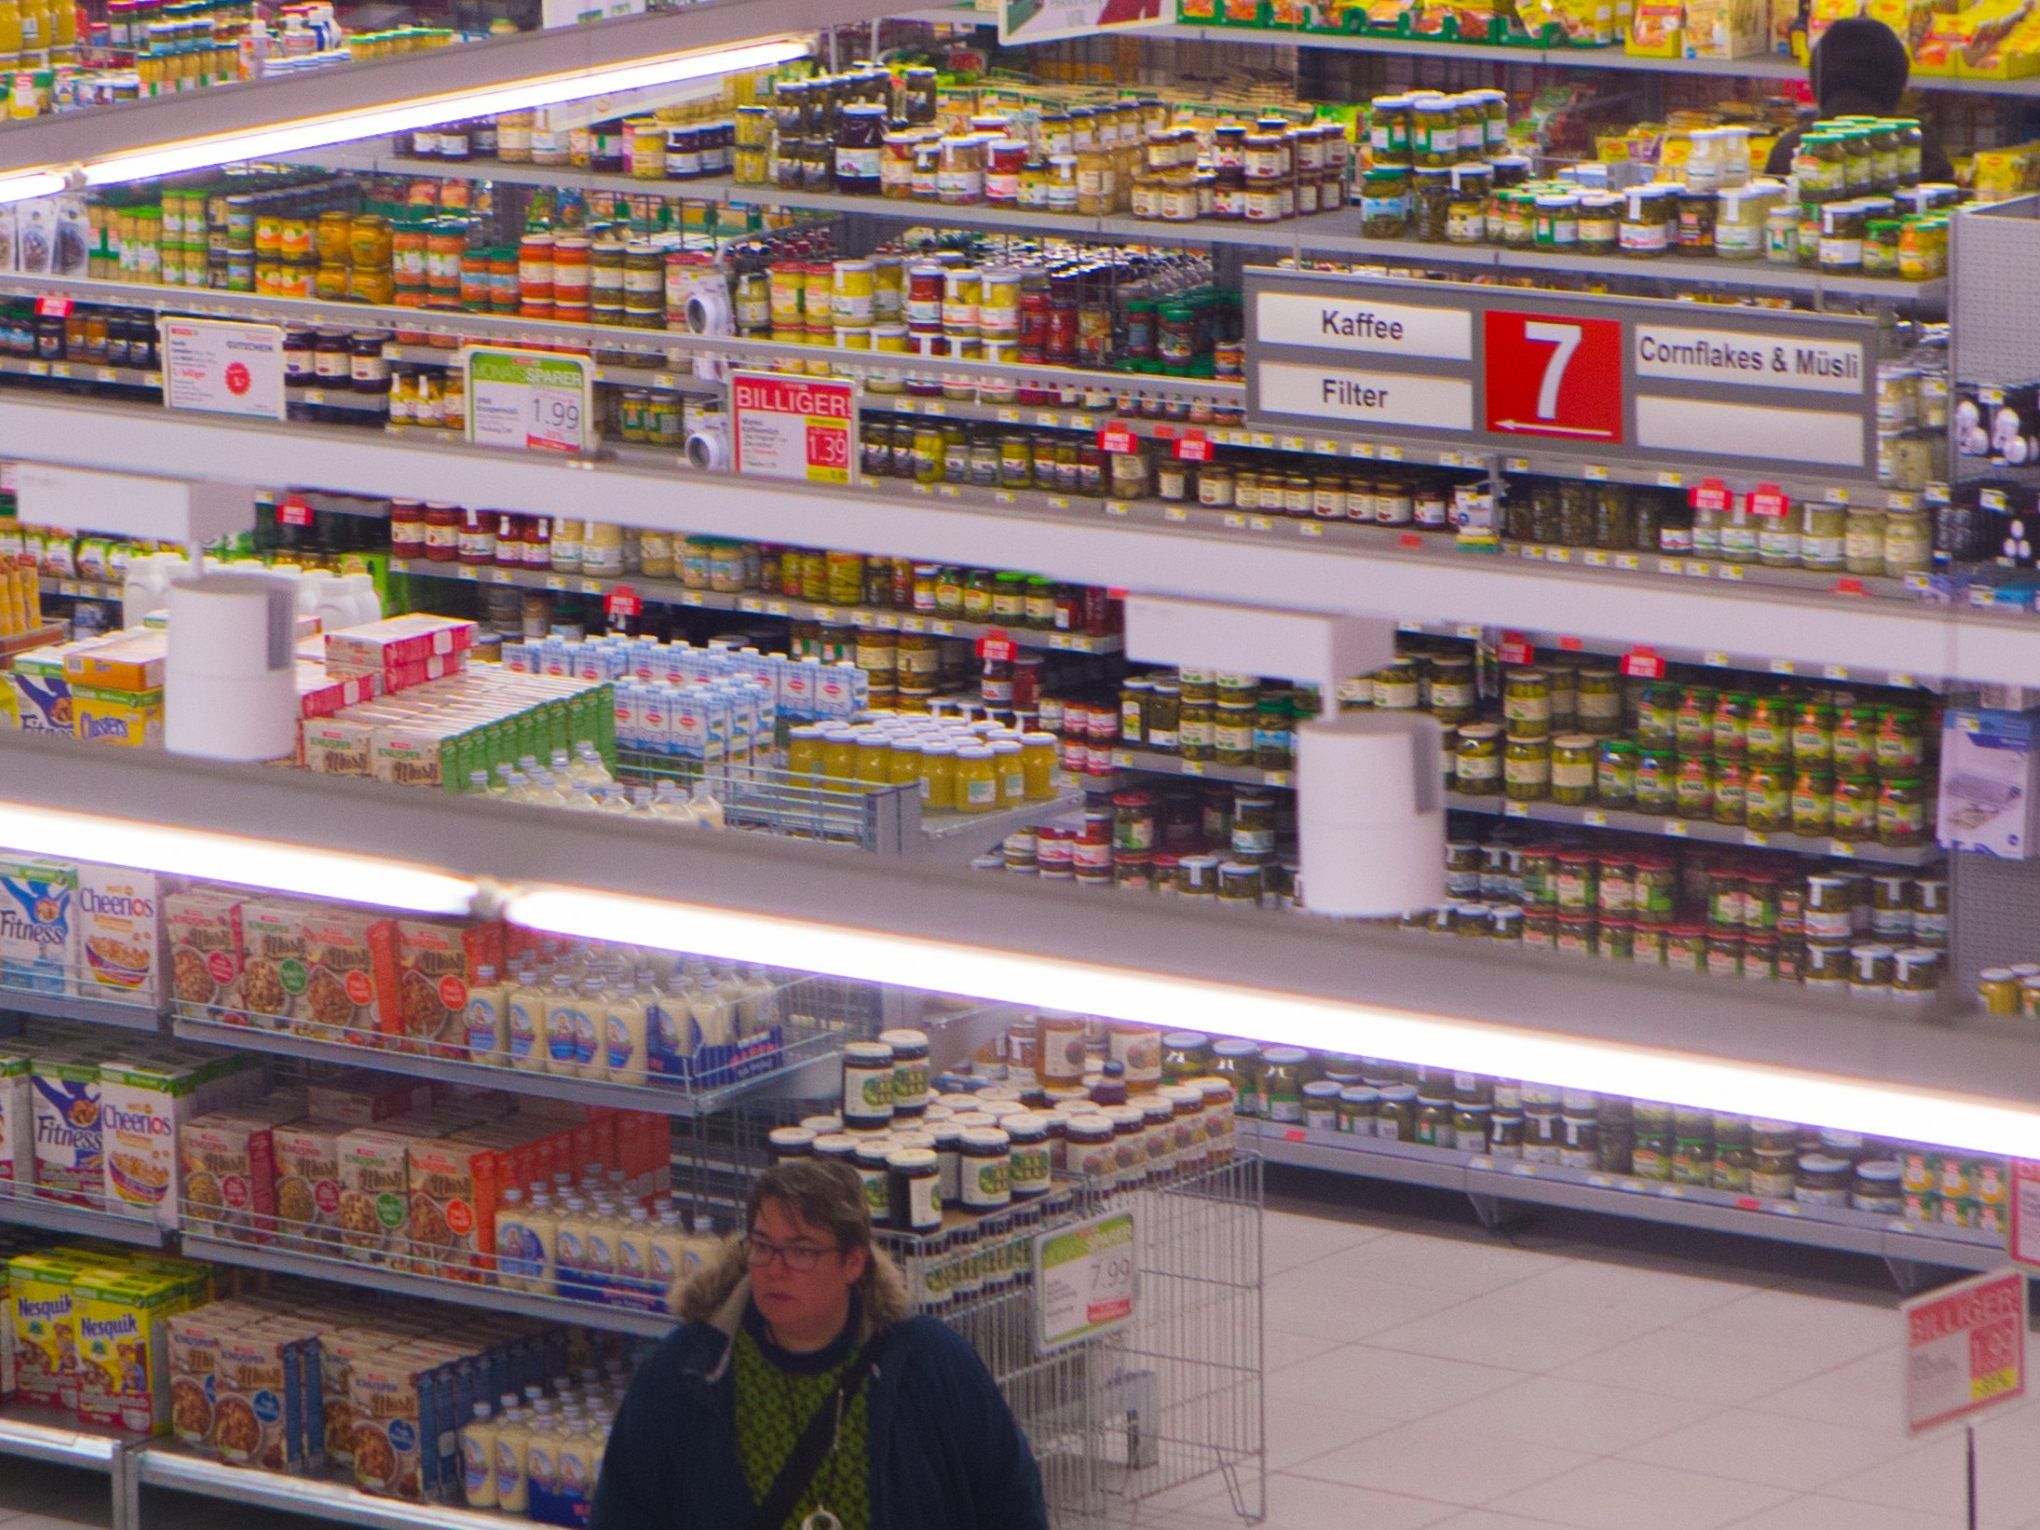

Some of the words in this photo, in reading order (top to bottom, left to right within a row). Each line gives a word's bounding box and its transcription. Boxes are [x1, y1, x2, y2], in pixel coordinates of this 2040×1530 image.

[1321, 309, 1404, 341] Kaffee
[1524, 320, 1582, 420] 7
[1639, 335, 1763, 372] Cornflakes
[1771, 346, 1788, 373] &
[1795, 348, 1859, 379] Müsli
[1321, 378, 1388, 409] Filter
[532, 398, 580, 430] 1.99
[808, 434, 847, 464] 1.39
[79, 886, 155, 919] Cheerios
[0, 908, 66, 946] Fitness
[36, 1114, 103, 1151] Fitness
[103, 1103, 173, 1138] Cheerios
[18, 1293, 73, 1322] Nesquik
[80, 1312, 138, 1341] Nesquik
